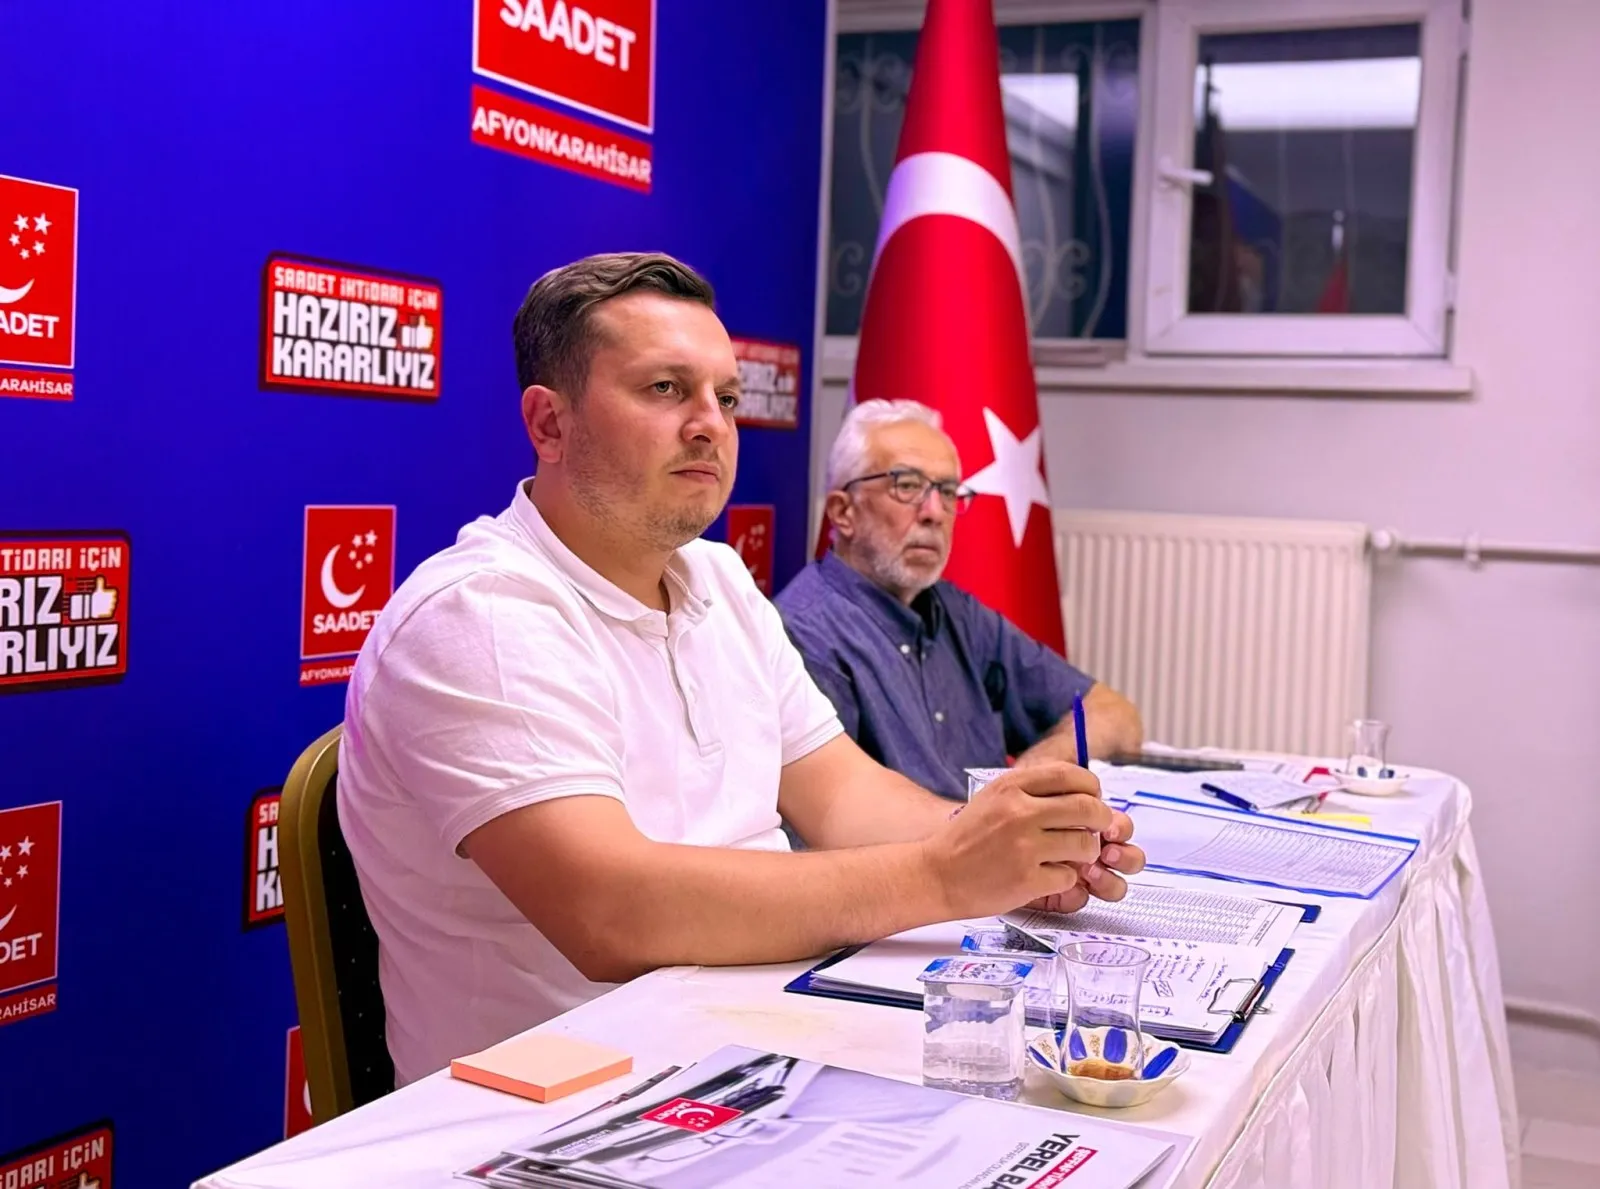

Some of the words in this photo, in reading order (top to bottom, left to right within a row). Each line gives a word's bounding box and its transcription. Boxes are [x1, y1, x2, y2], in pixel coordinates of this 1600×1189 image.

[500, 0, 636, 72] SAADET
[472, 106, 652, 183] AFYONKARAHİSAR
[273, 266, 336, 295] SAADET
[273, 291, 398, 349] HAZIRIZ
[272, 335, 436, 390] KARARLIYIZ
[0, 993, 56, 1020] AHİSAR
[1008, 1133, 1081, 1172] YEREL
